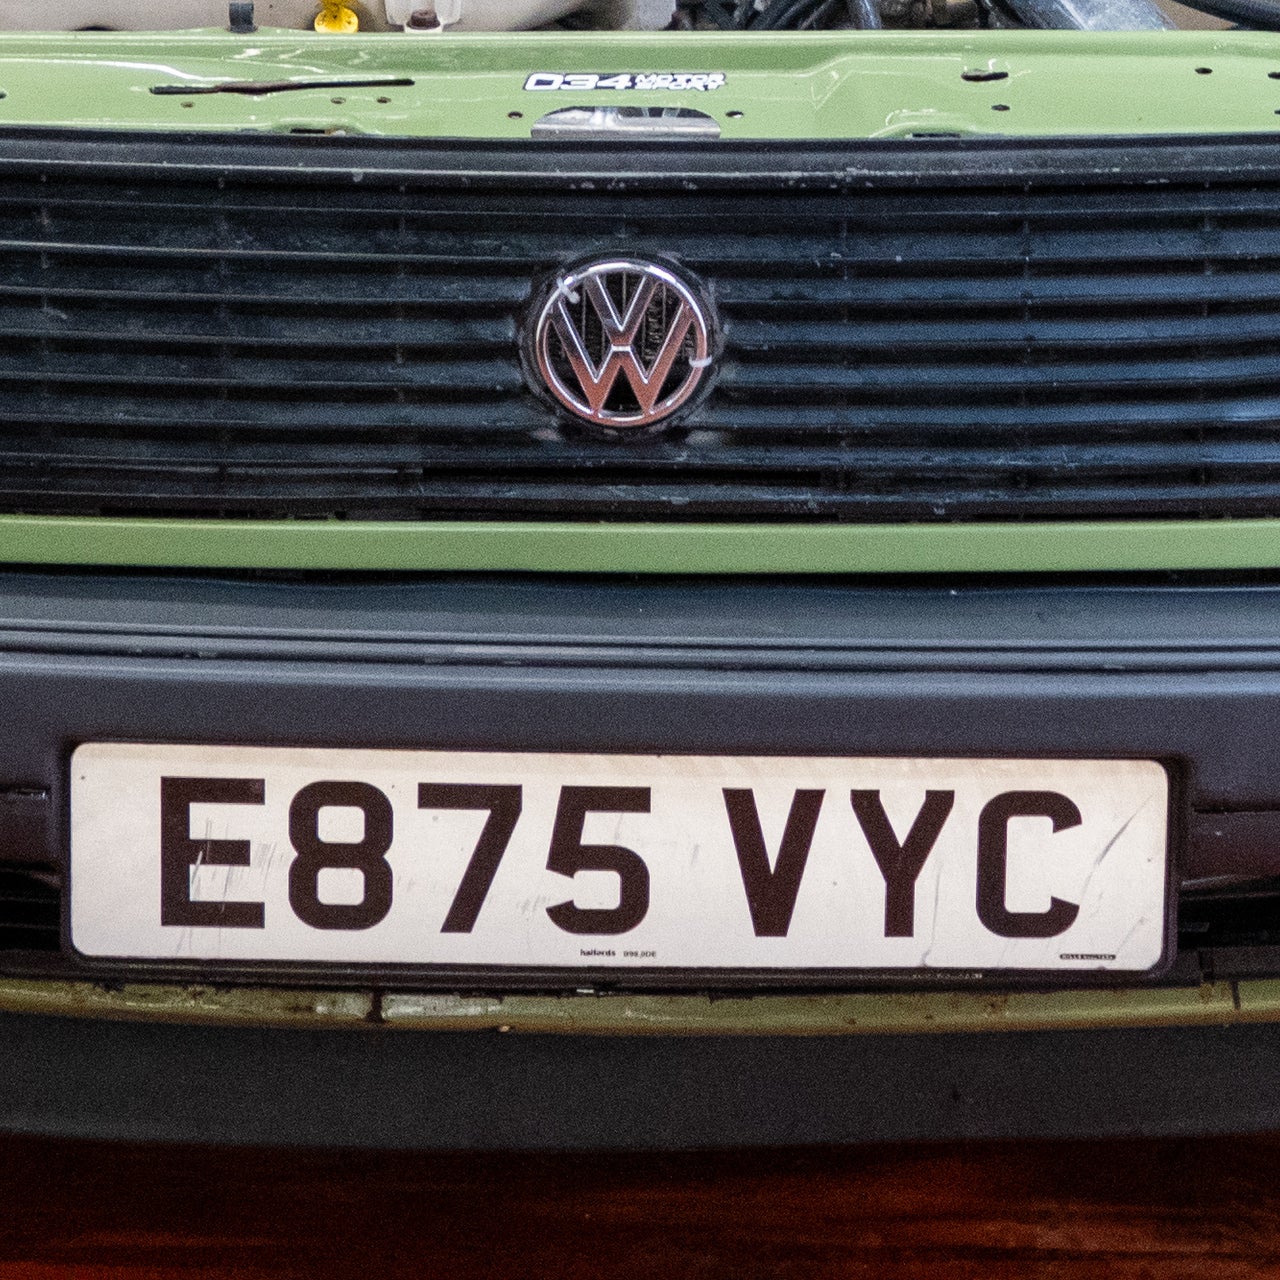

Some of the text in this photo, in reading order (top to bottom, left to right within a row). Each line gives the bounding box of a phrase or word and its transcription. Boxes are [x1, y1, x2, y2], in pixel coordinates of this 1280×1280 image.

[525, 73, 632, 91] 034
[160, 775, 1084, 939] E875 VYC
